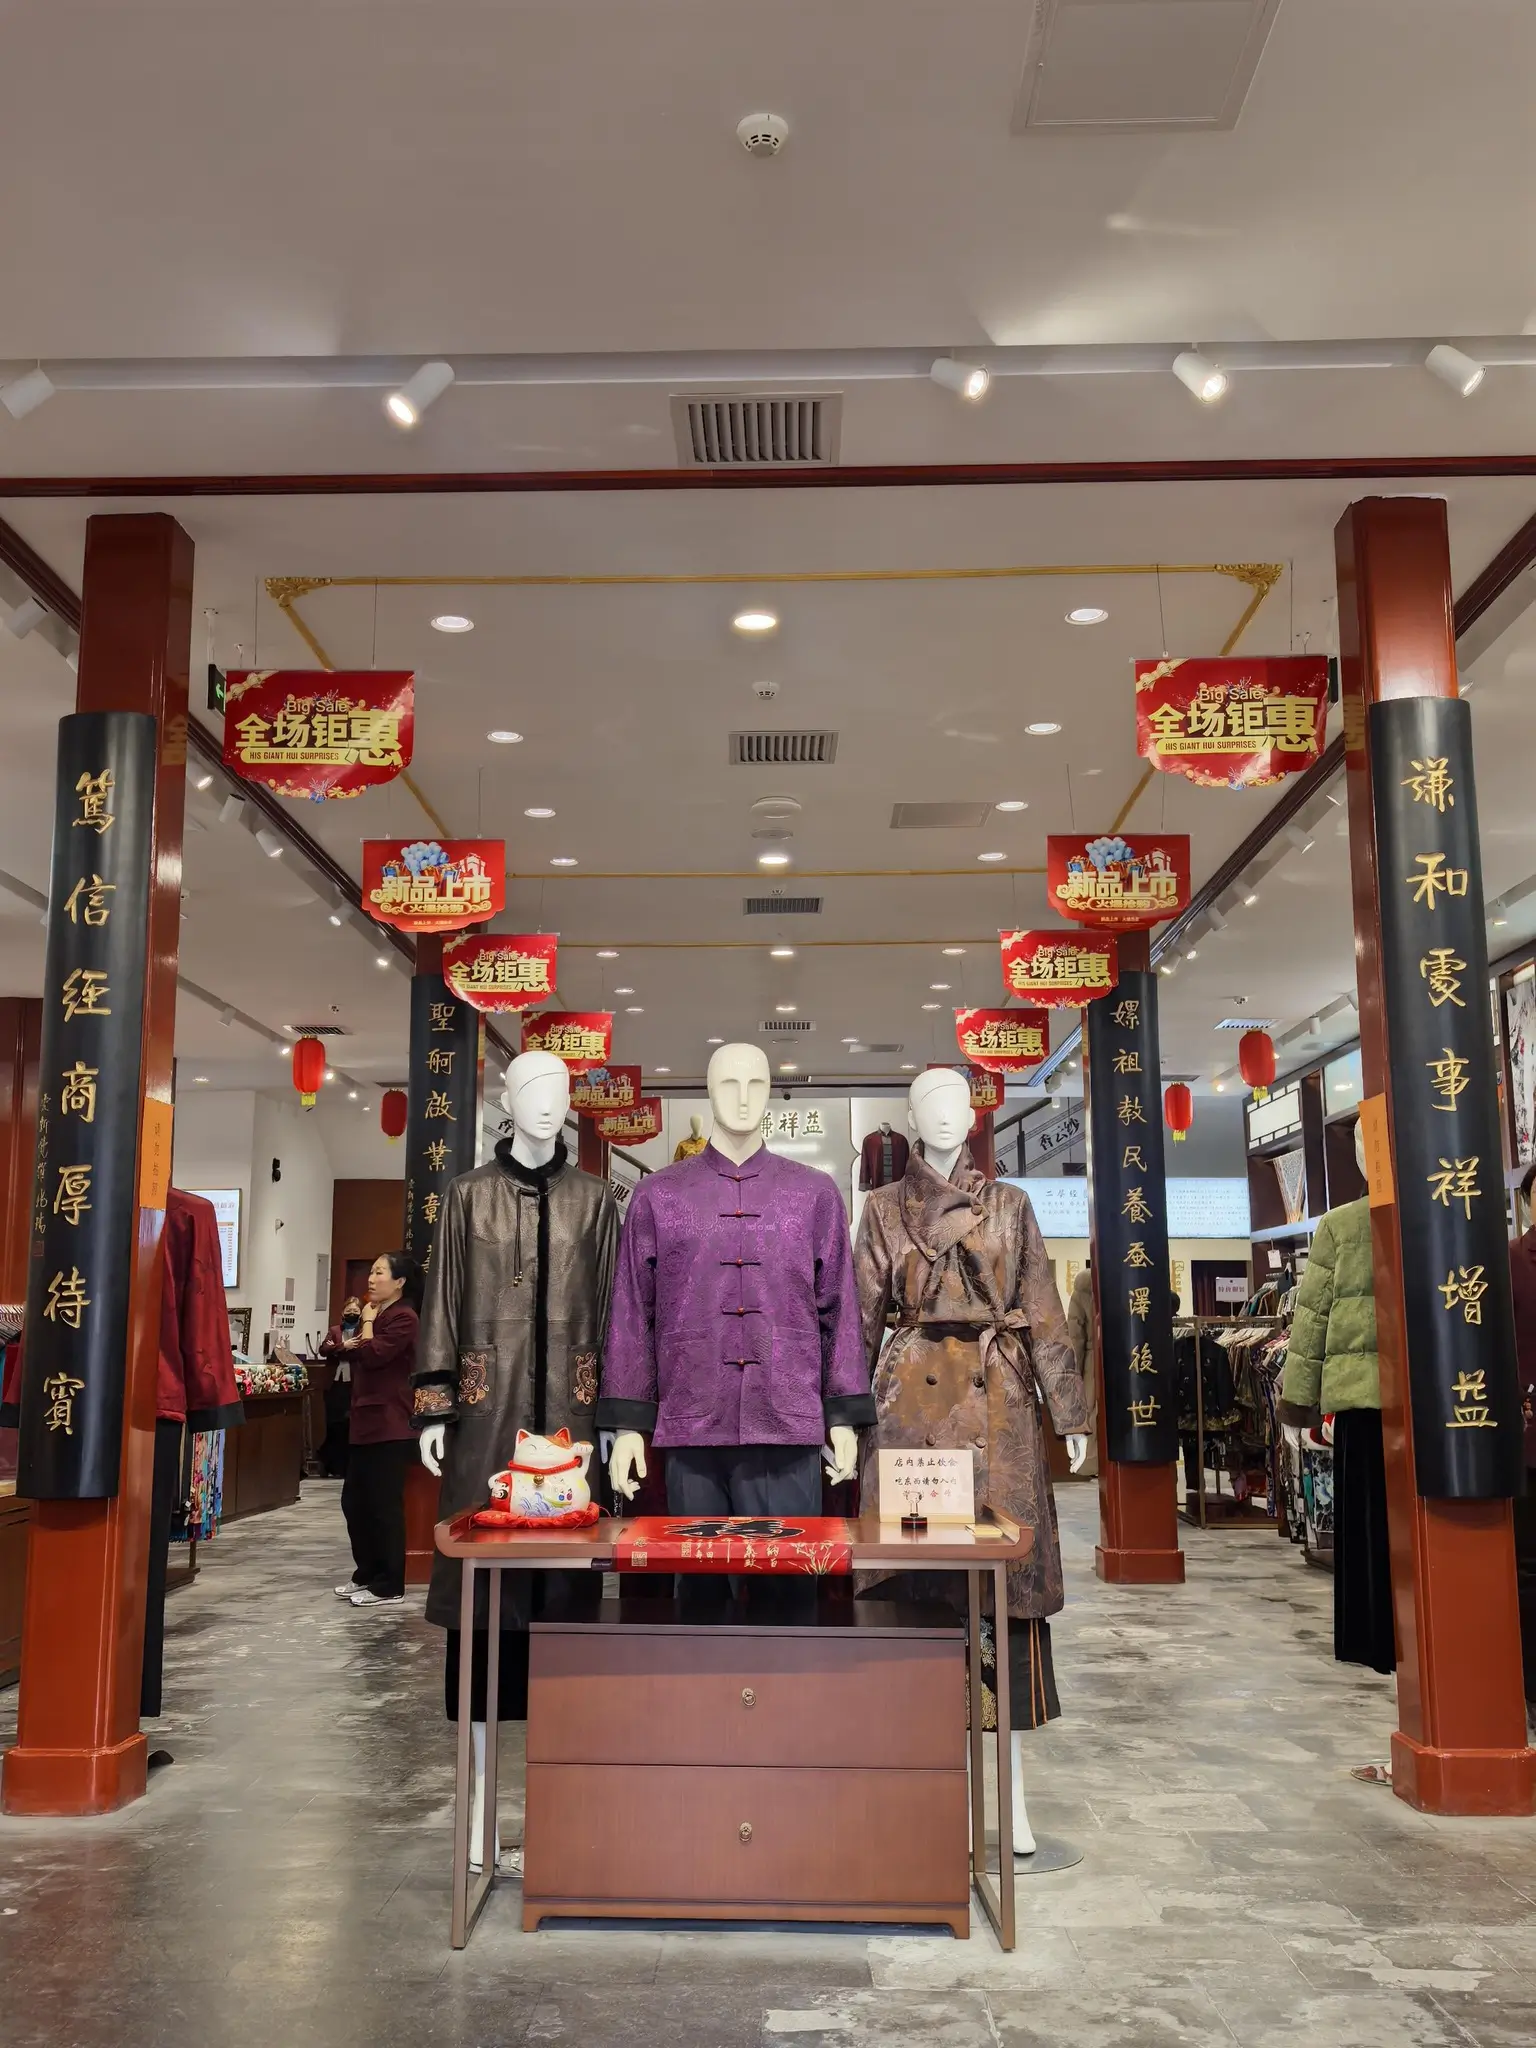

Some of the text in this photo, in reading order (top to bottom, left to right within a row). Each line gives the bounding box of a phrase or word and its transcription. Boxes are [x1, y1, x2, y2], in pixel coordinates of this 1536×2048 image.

[286, 701, 348, 714] Big Sale
[1200, 689, 1262, 703] Big Sale
[234, 708, 403, 767] 全场钜惠
[1147, 695, 1318, 753] 全场钜惠
[249, 752, 339, 761] HIS GIANT HUI SURPRISES
[1165, 740, 1257, 751] HIS GIANT HUI SURPRISES
[381, 874, 493, 903] 新品上市
[1067, 871, 1178, 899] 新品上市
[479, 952, 494, 962] Big
[1008, 953, 1112, 988] 全场钜惠
[448, 958, 550, 993] 全场钜惠
[526, 1032, 607, 1060] 全场钜惠
[961, 1028, 1044, 1056] 全场钜惠
